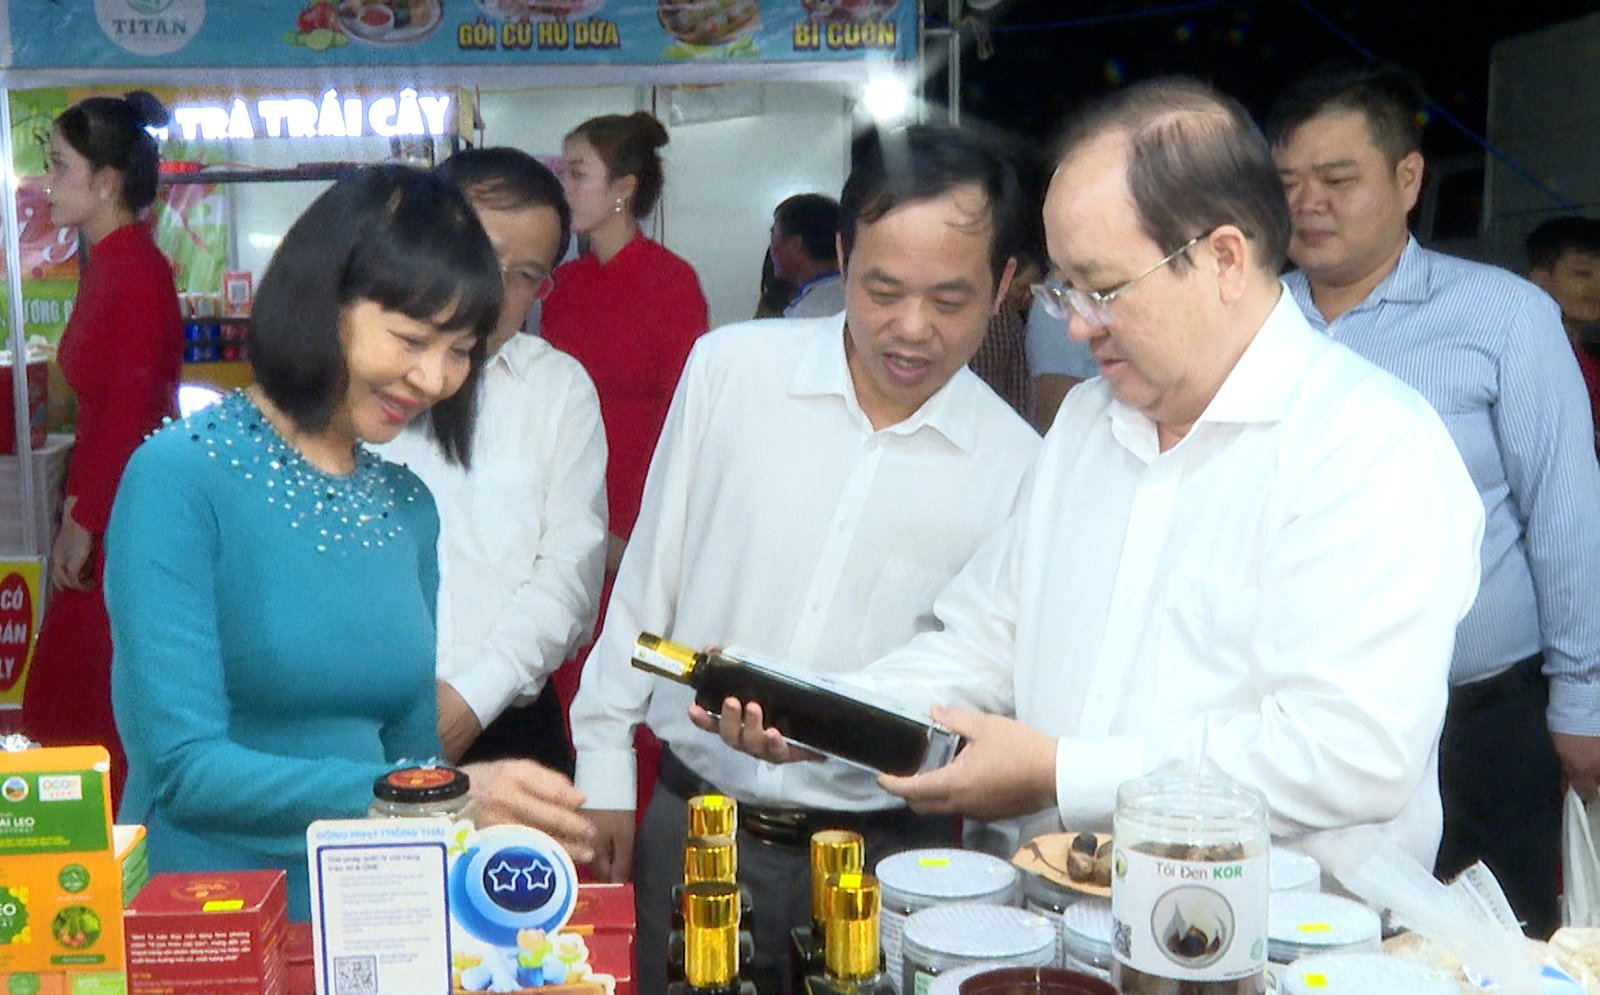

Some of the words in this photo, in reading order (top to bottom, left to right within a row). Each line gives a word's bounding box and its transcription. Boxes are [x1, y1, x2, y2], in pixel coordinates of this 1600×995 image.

[112, 19, 186, 35] TITAN
[174, 98, 254, 140] TRÀ
[257, 88, 362, 137] TRÁI
[368, 87, 450, 137] CÂY
[1213, 865, 1242, 879] KOR
